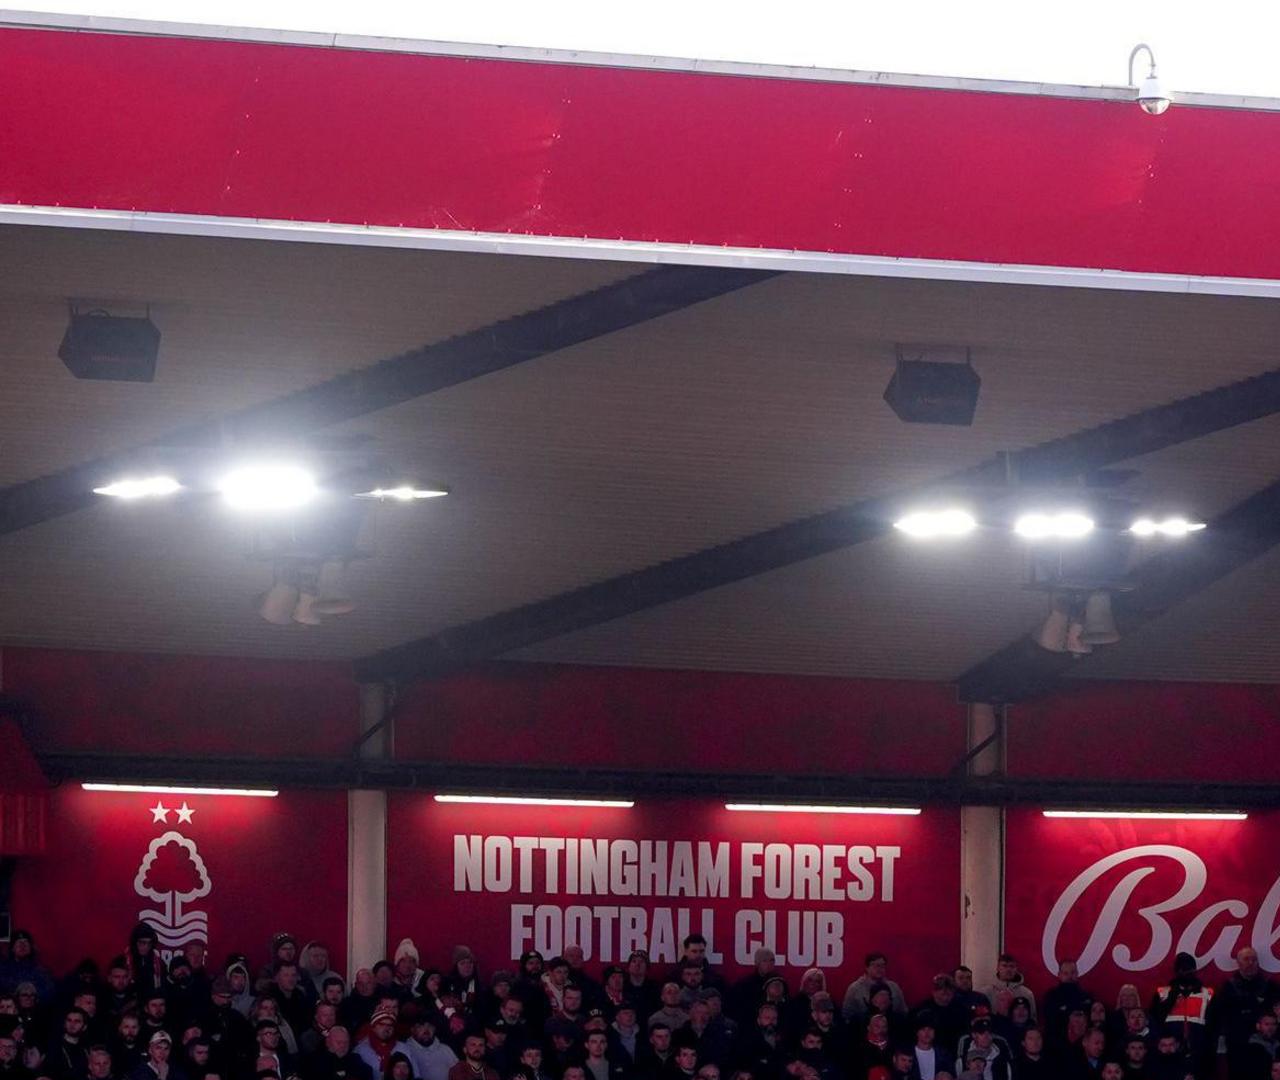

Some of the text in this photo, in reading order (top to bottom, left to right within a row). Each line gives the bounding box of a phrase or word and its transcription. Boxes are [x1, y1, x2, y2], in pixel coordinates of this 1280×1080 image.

[454, 834, 901, 902] NOTTINGHAM FOREST
[511, 904, 844, 967] FOOTBALL CLUB
